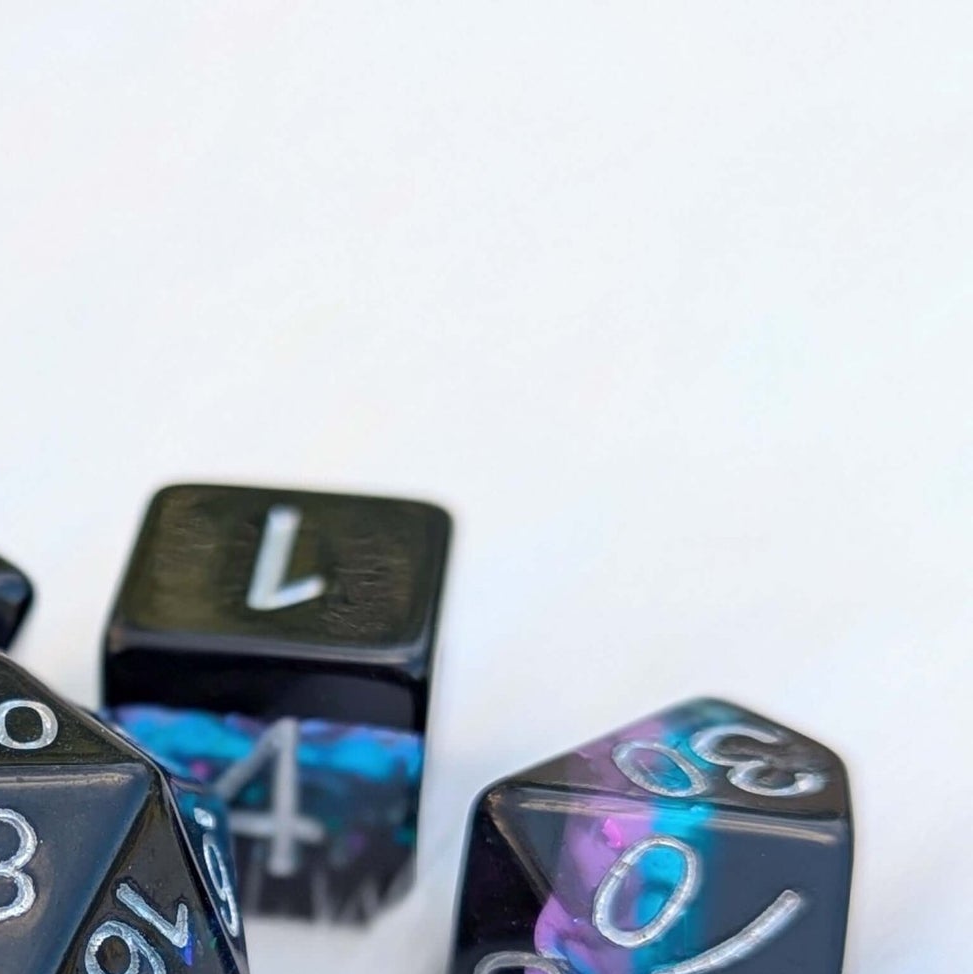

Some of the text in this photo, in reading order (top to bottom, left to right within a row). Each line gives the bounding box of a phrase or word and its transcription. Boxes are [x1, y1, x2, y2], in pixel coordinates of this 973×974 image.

[247, 507, 325, 610] 1
[214, 718, 324, 876] 4
[612, 725, 825, 797] 30
